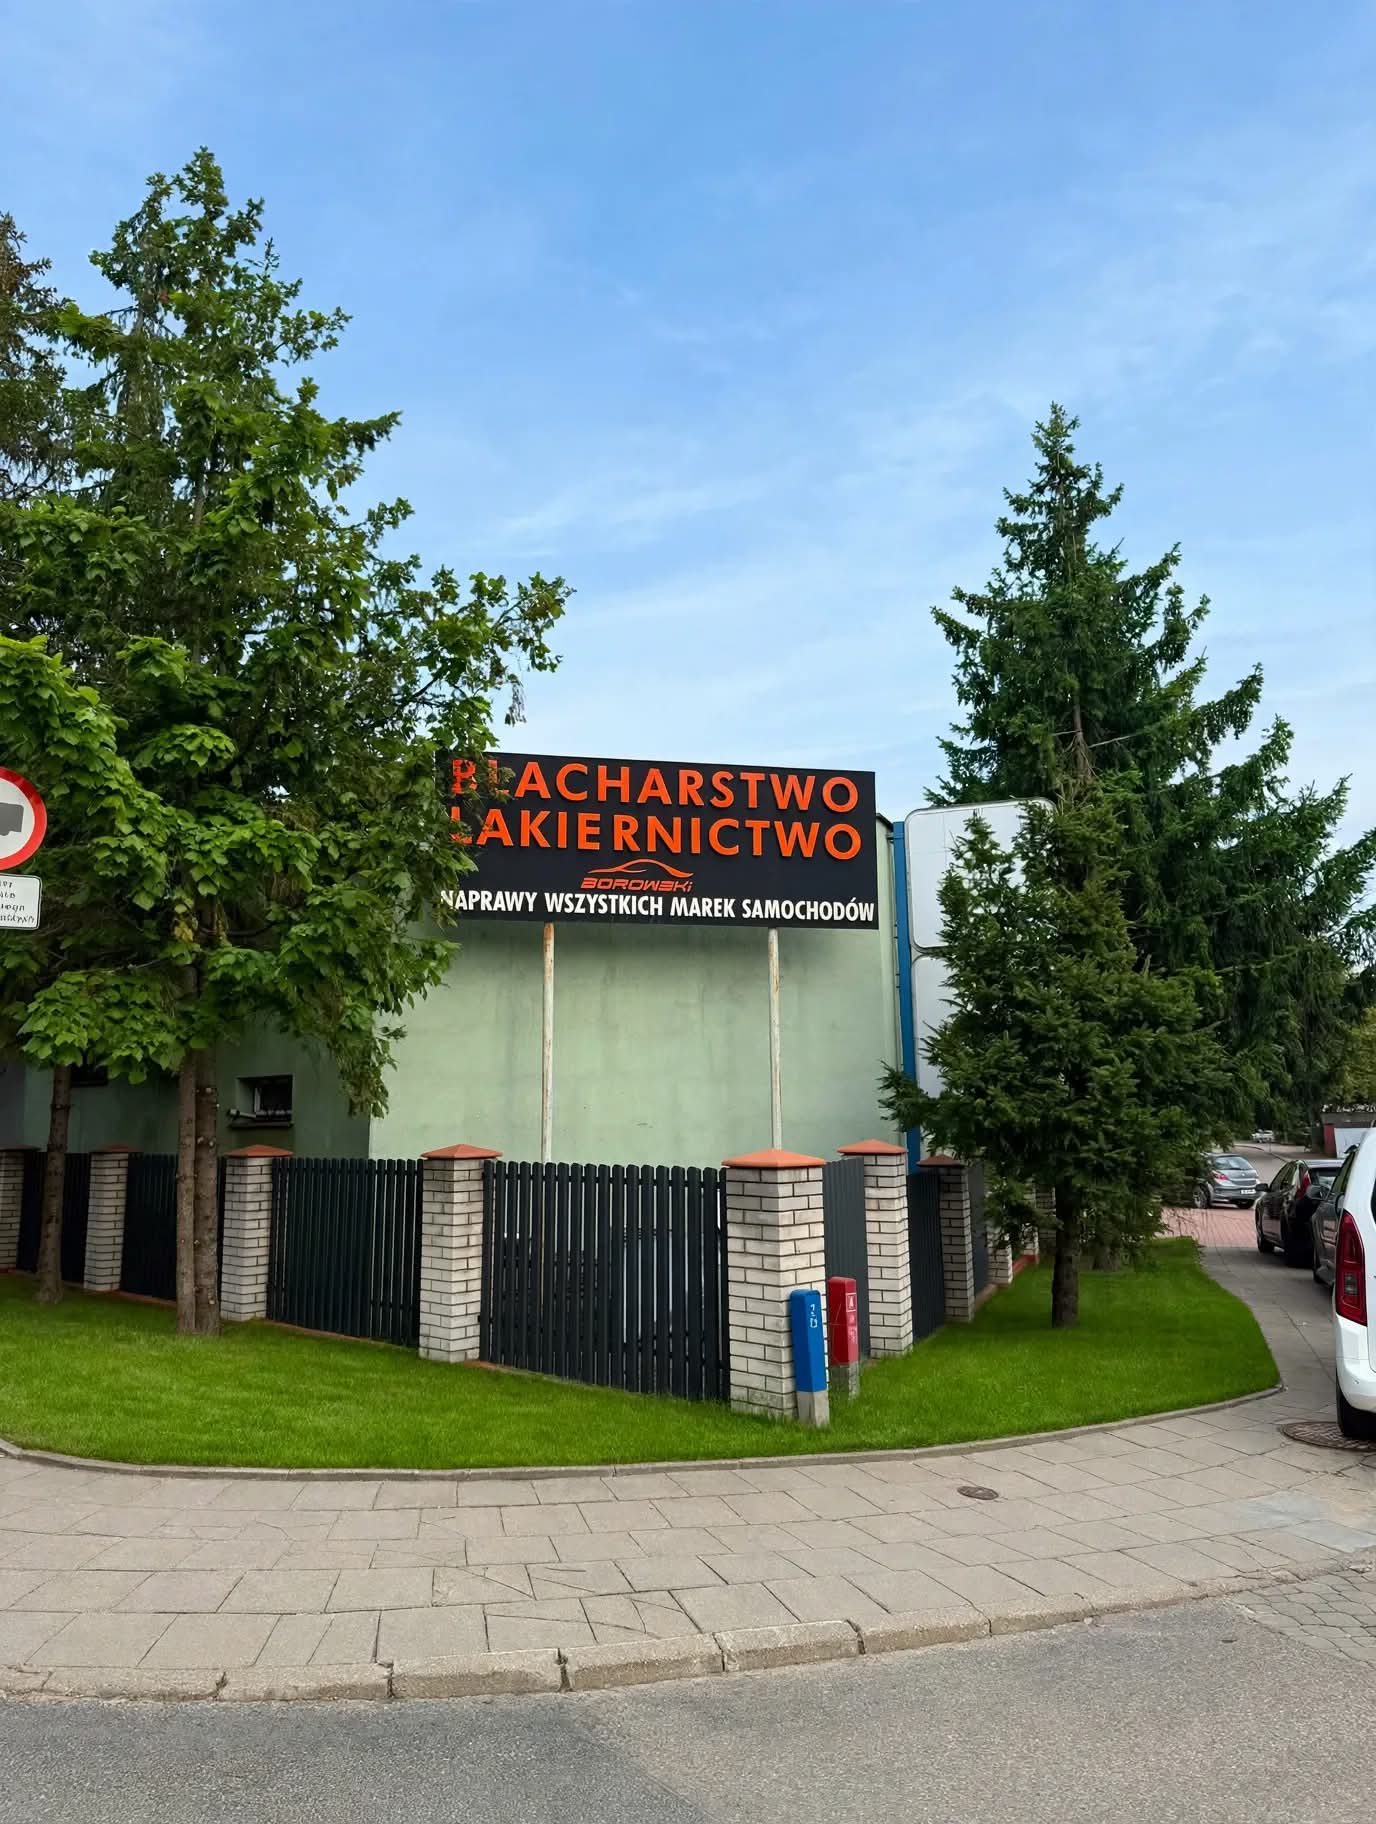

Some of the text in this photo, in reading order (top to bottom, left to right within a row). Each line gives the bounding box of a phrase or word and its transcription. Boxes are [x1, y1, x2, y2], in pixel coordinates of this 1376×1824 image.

[450, 806, 862, 860] LAKIERNICTWO
[440, 890, 875, 922] NAPRAWY WSZYSTKICH MAREK SAMOCHODÓW
